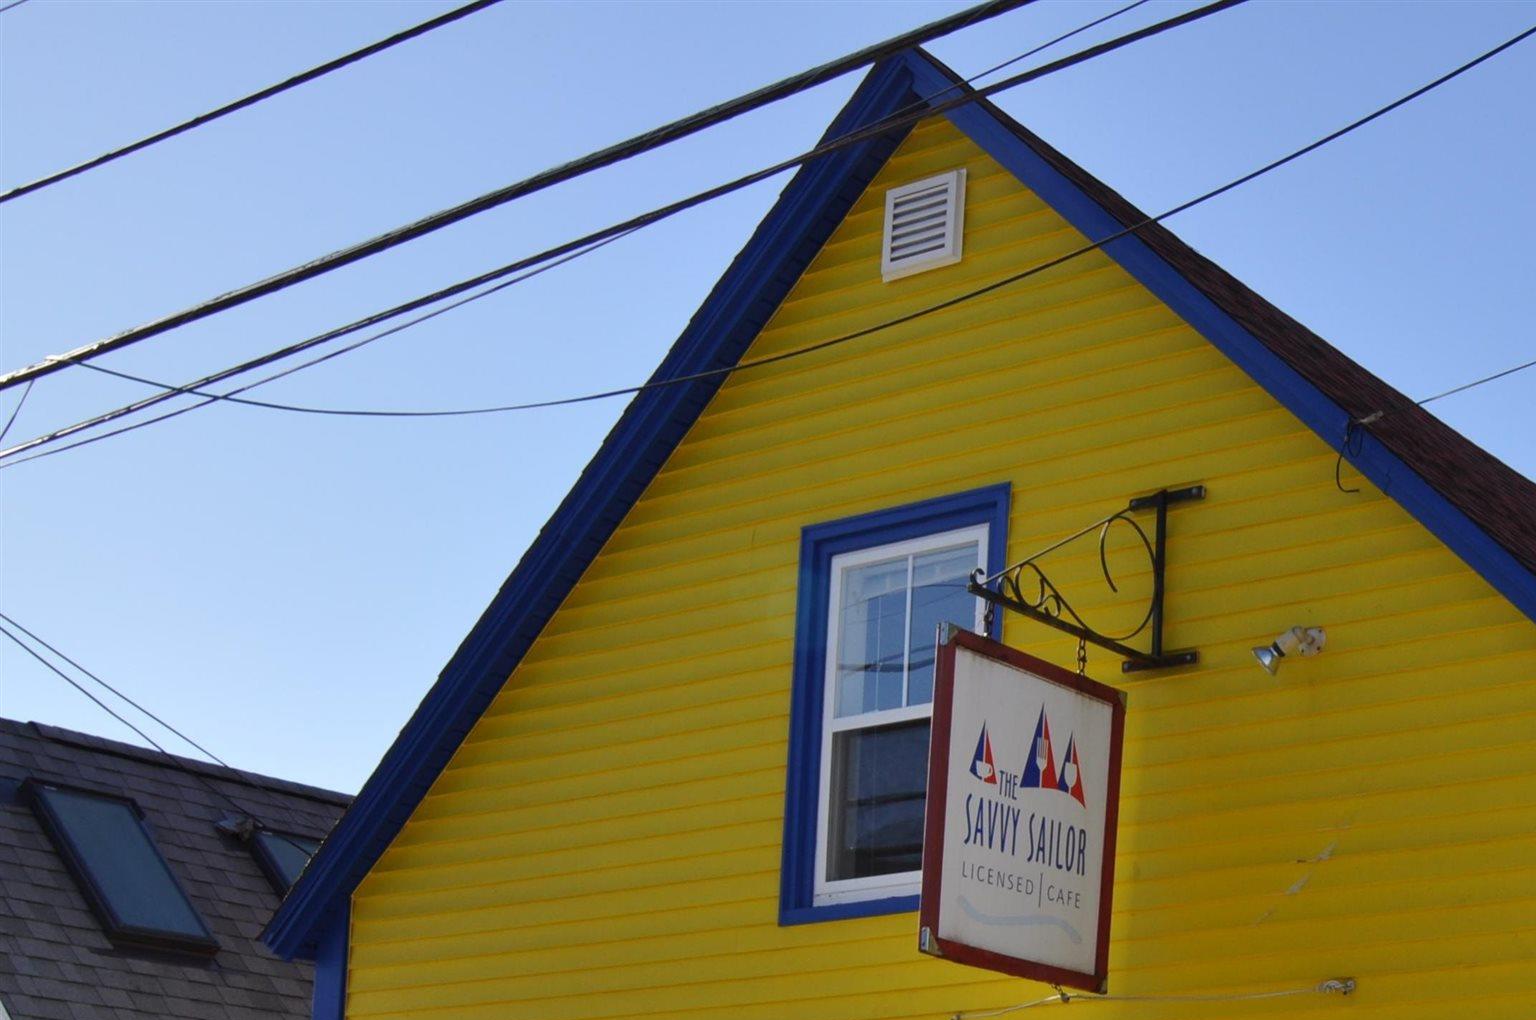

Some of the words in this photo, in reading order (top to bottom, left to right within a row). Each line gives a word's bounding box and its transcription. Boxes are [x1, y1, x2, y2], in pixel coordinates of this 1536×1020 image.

[999, 770, 1019, 800] THE
[964, 793, 1021, 856] SAVVY
[1027, 812, 1087, 877] SAILOR
[962, 861, 1034, 895] LICENSED
[1047, 885, 1081, 910] CAFE
